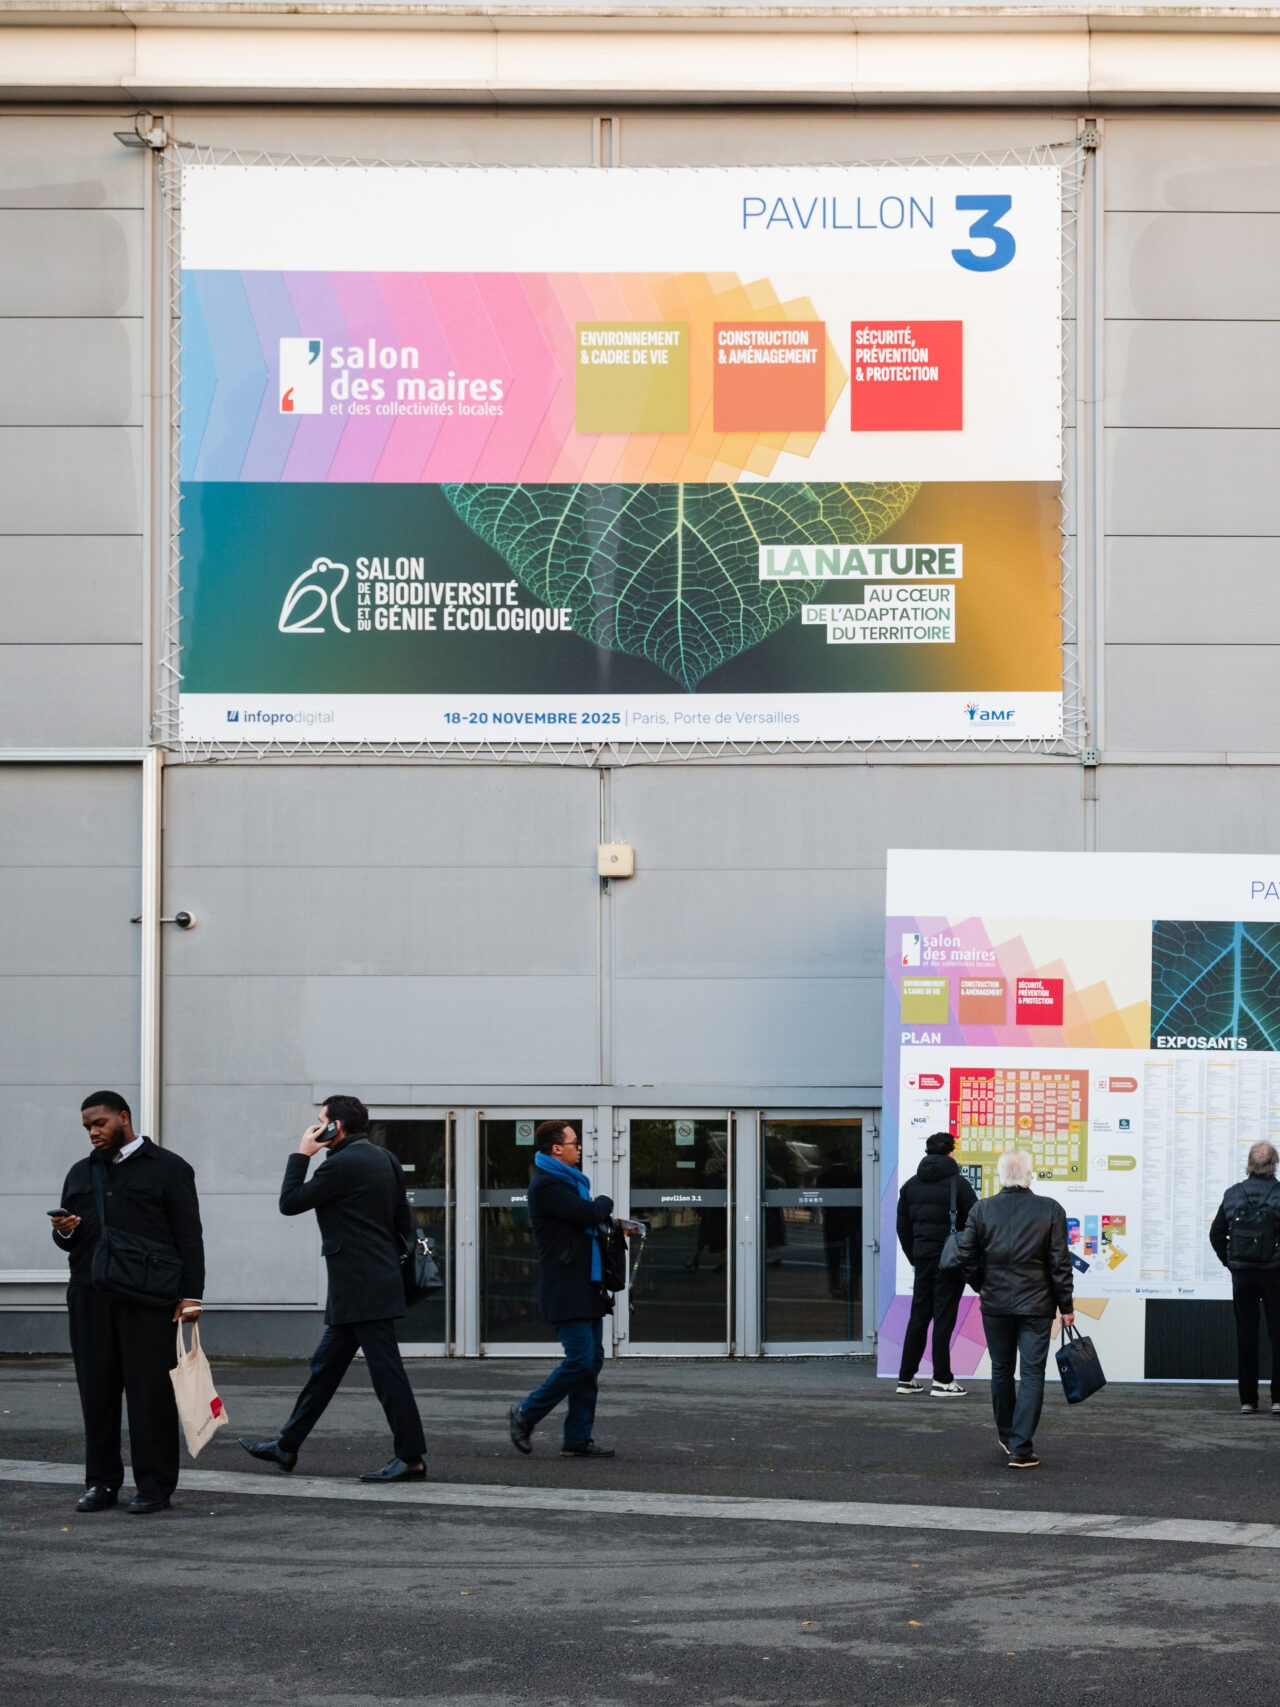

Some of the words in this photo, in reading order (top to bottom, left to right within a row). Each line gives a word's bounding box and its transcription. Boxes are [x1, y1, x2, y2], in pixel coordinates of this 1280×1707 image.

[743, 196, 934, 229] PAVILLON
[951, 195, 1016, 272] 3
[580, 331, 680, 347] ENVIRONNEMENT
[718, 330, 809, 346] CONSTRUCTION
[855, 327, 916, 347] SÉCURITÉ,
[329, 338, 419, 369] salon
[580, 349, 589, 365] &
[591, 349, 629, 365] CADRE
[632, 349, 648, 365] DE
[650, 349, 669, 365] VIE
[718, 349, 727, 365] &
[728, 346, 818, 365] AMÉNAGEMENT
[855, 346, 928, 364] PRÉVENTION
[855, 366, 864, 382] &
[866, 366, 939, 382] PROTECTION
[330, 370, 385, 401] des
[398, 371, 504, 401] maires
[329, 402, 343, 415] et
[348, 402, 372, 415] des
[375, 401, 454, 416] collectivités
[458, 402, 504, 416] locales
[356, 557, 424, 580] SALON
[766, 548, 809, 577] LA
[815, 548, 956, 576] NATURE
[358, 583, 371, 594] DE
[375, 580, 518, 605] BIODIVERSITÉ
[869, 589, 893, 602] AU
[896, 588, 950, 602] CŒUR
[358, 594, 371, 605] LA
[358, 608, 370, 619] ET
[375, 605, 437, 630] GÉNIE
[443, 605, 572, 633] ÉCOLOGIQUE
[806, 608, 828, 622] DE
[831, 607, 950, 622] L’ADAPTATION
[358, 620, 371, 631] DU
[832, 627, 856, 640] DU
[860, 626, 951, 640] TERRITOIRE
[243, 710, 334, 725] infoprodigital
[443, 712, 488, 725] 18-20
[492, 712, 577, 725] NOVEMBRE
[581, 712, 621, 725] 2025
[632, 711, 670, 726] Paris,
[673, 711, 711, 725] Porte
[714, 711, 732, 725] de
[735, 711, 800, 724] Versailles
[923, 934, 961, 948] salon
[923, 948, 946, 960] des
[950, 948, 996, 961] maires
[901, 1032, 941, 1044] PLAN
[1157, 1036, 1248, 1050] EXPOSANTS
